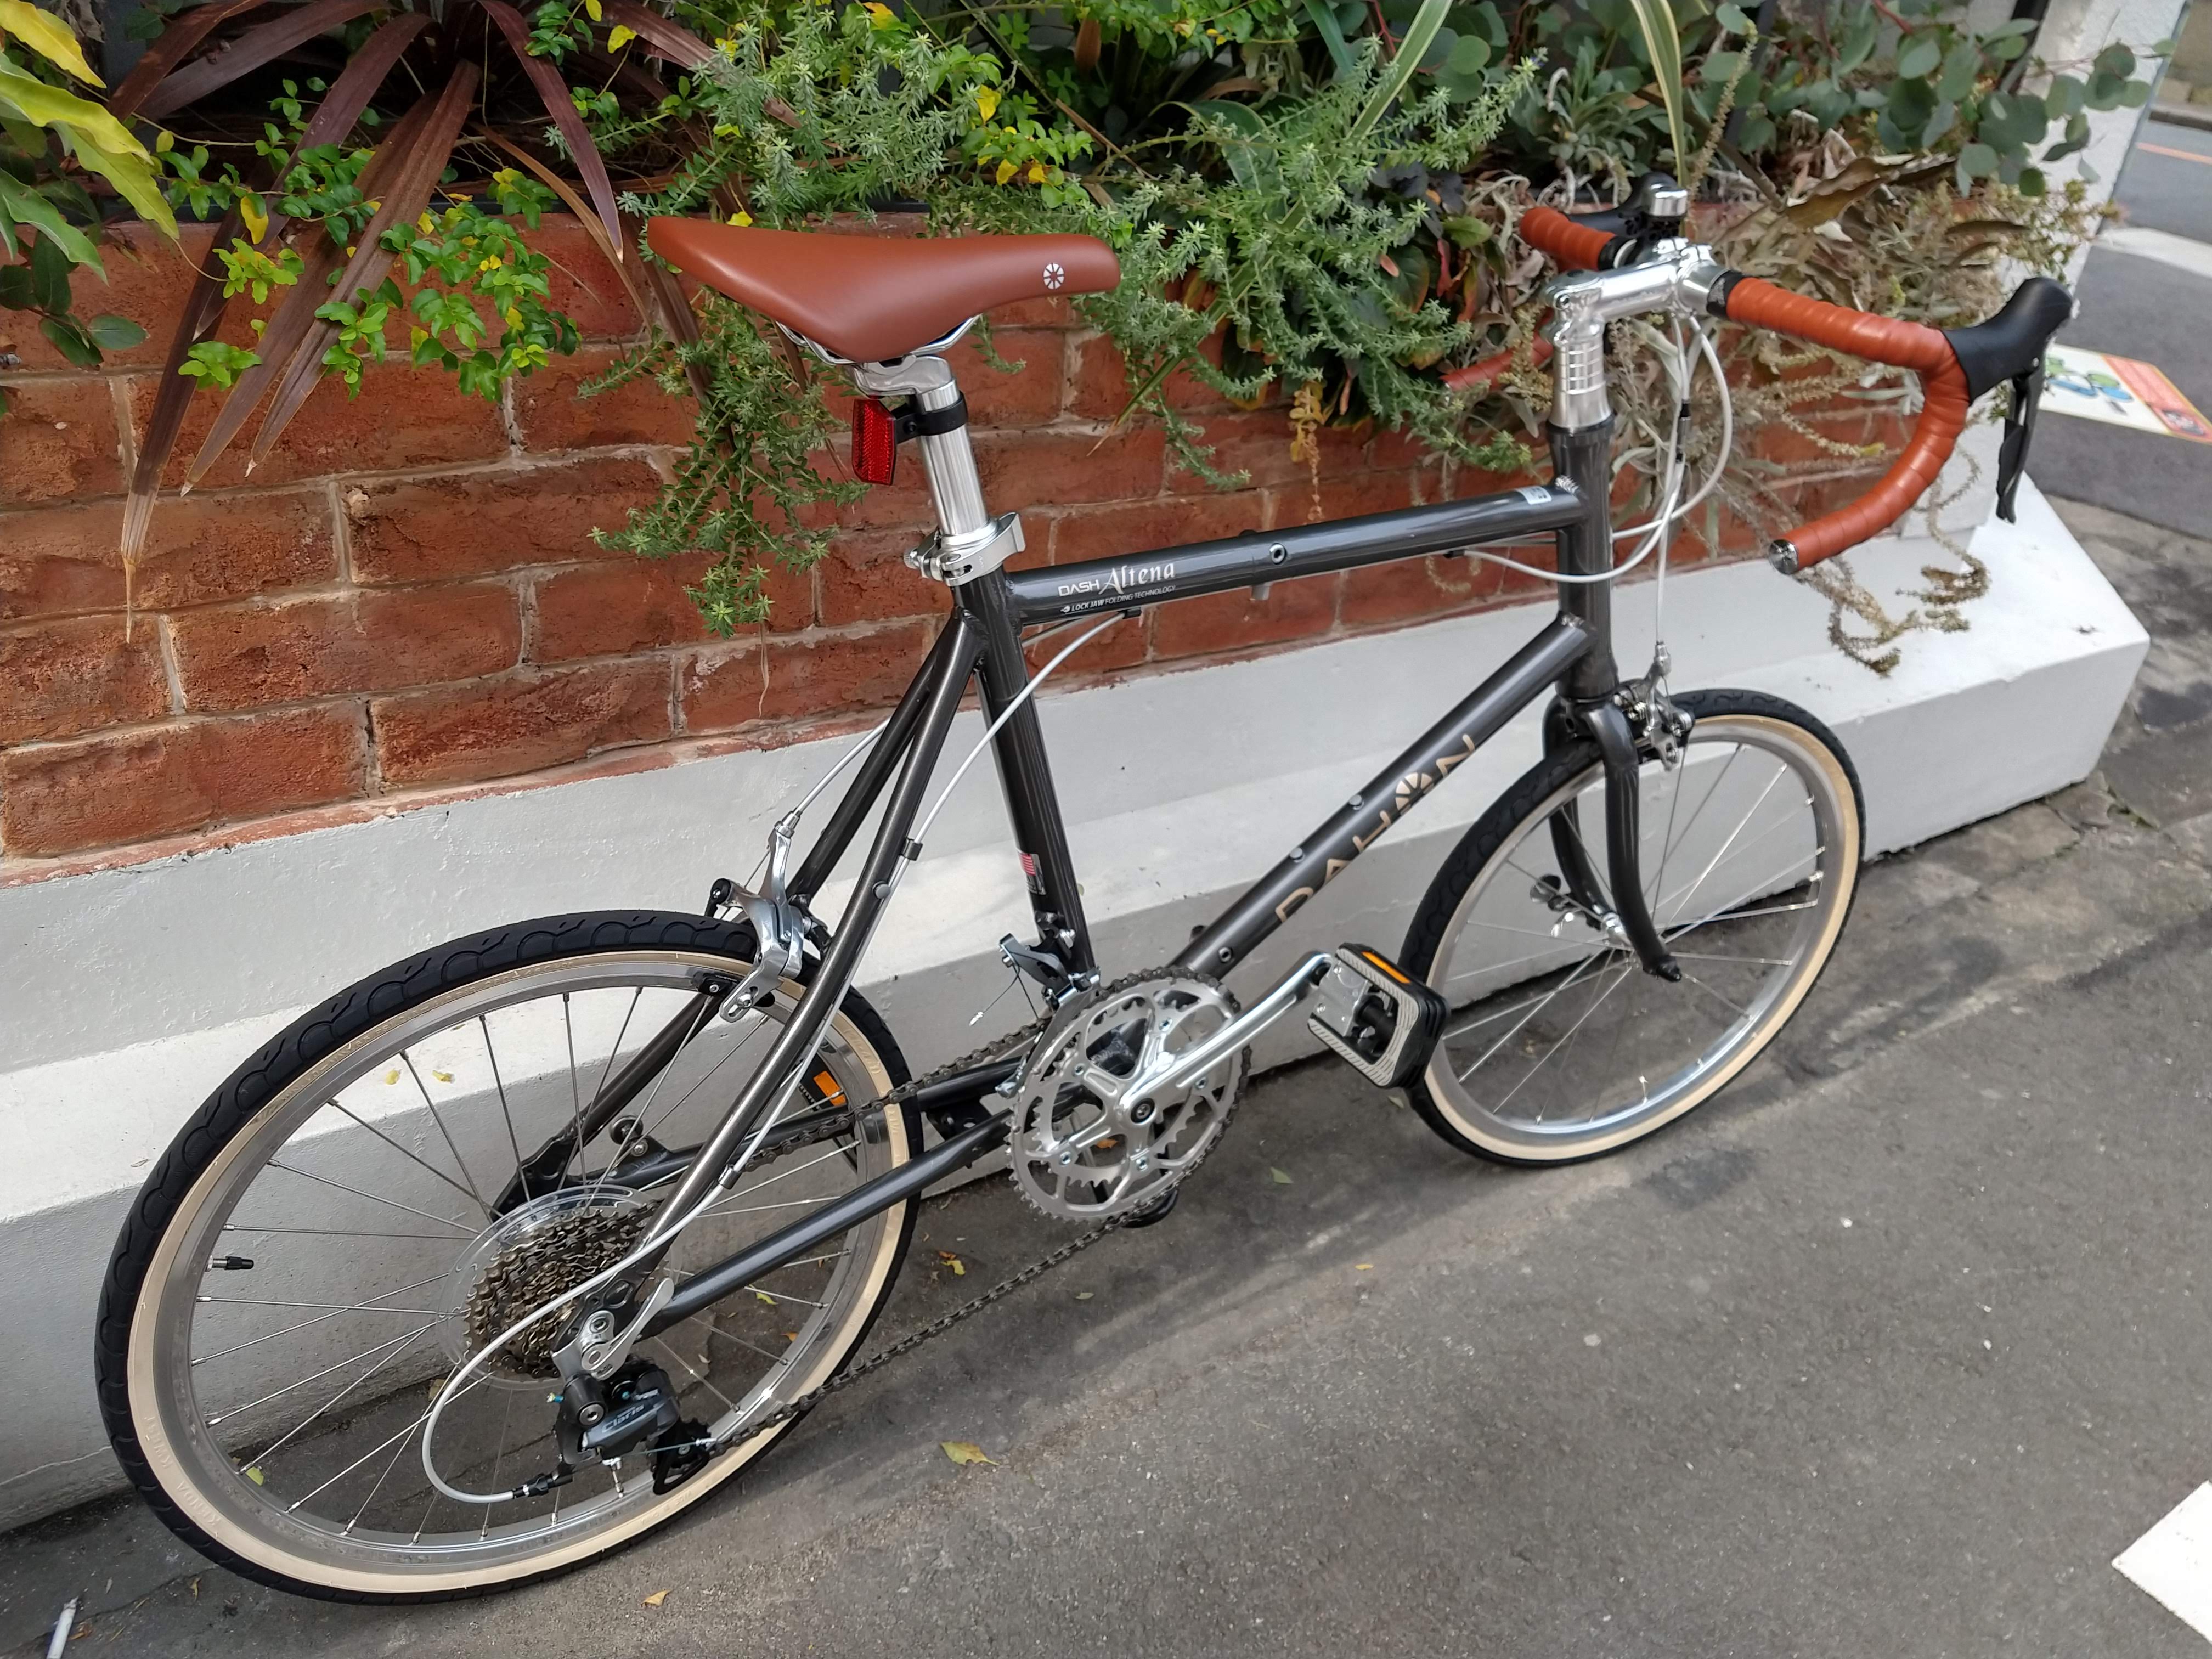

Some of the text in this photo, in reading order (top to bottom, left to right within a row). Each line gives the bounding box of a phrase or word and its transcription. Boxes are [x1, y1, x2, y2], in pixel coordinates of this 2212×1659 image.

[1058, 563, 1175, 597] DASH Altena
[1071, 585, 1176, 612] LOCK JAW FOLDING TECHNOLOGY
